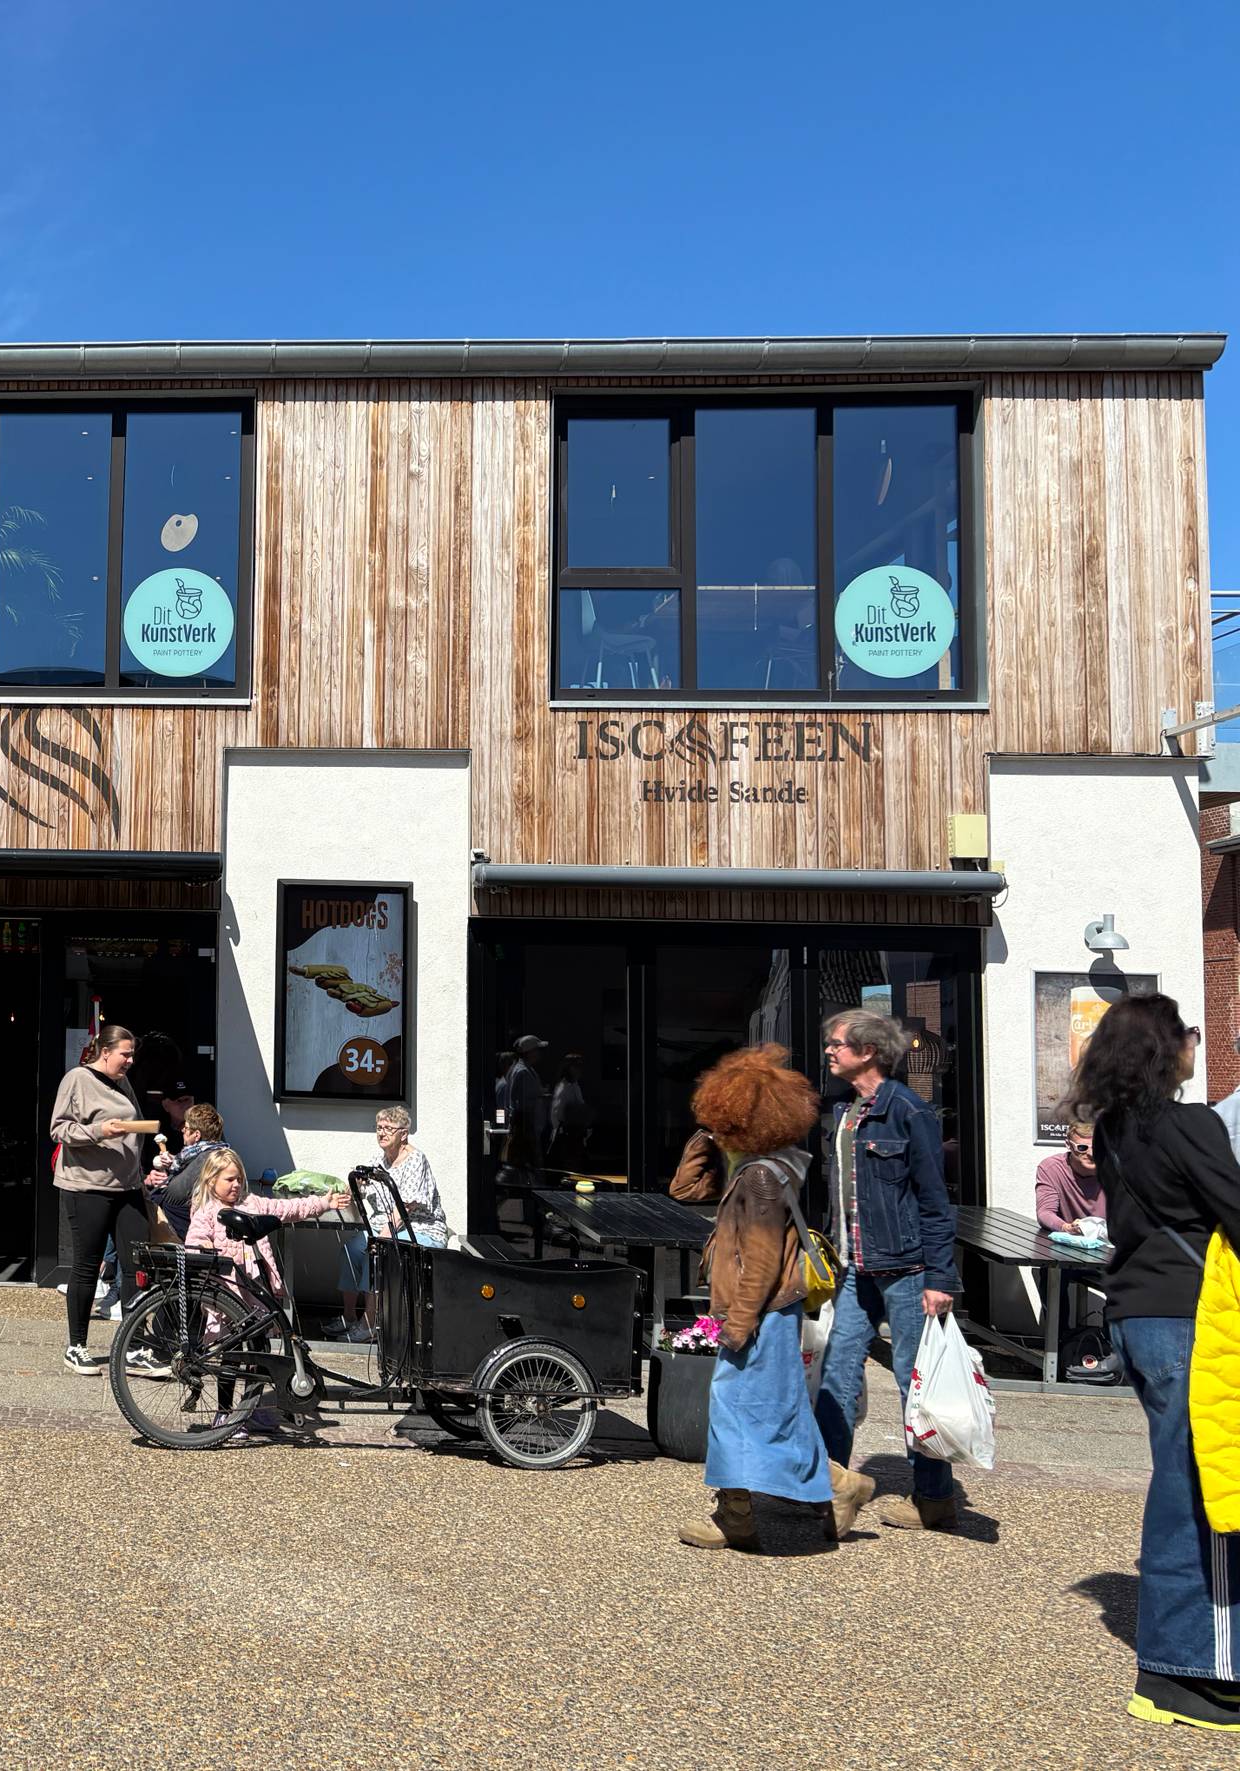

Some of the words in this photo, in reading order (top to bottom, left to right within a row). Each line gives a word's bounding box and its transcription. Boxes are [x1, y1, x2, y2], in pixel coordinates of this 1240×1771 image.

[154, 607, 172, 625] Dit
[867, 605, 887, 624] Dit
[141, 622, 216, 642] KunstVerk
[855, 621, 936, 642] KunstVerk
[640, 780, 718, 803] Hvide
[729, 780, 809, 804] Sande
[301, 899, 388, 930] HOTDOGS
